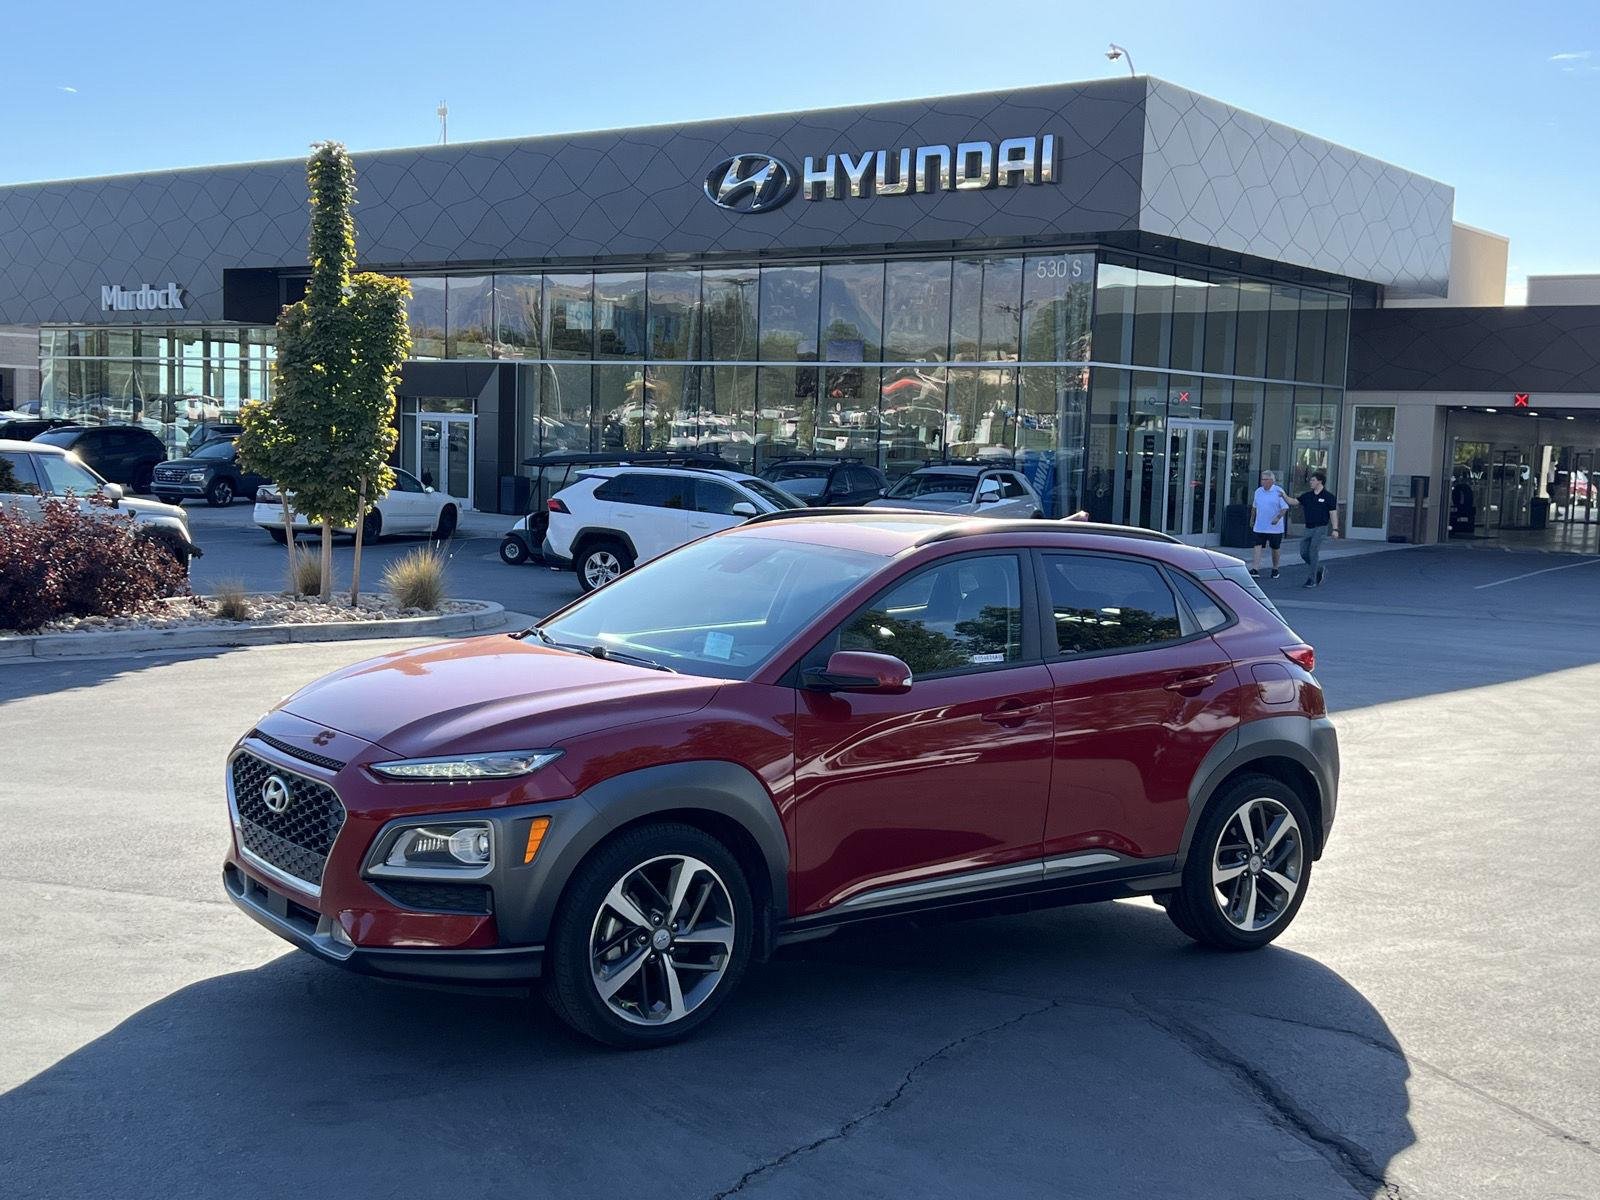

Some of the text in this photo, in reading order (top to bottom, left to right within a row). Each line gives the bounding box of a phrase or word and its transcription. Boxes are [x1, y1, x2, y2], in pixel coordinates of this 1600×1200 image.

[803, 134, 1055, 199] HYUNDAI
[1036, 259, 1082, 279] 530 S
[101, 282, 184, 311] Murdock
